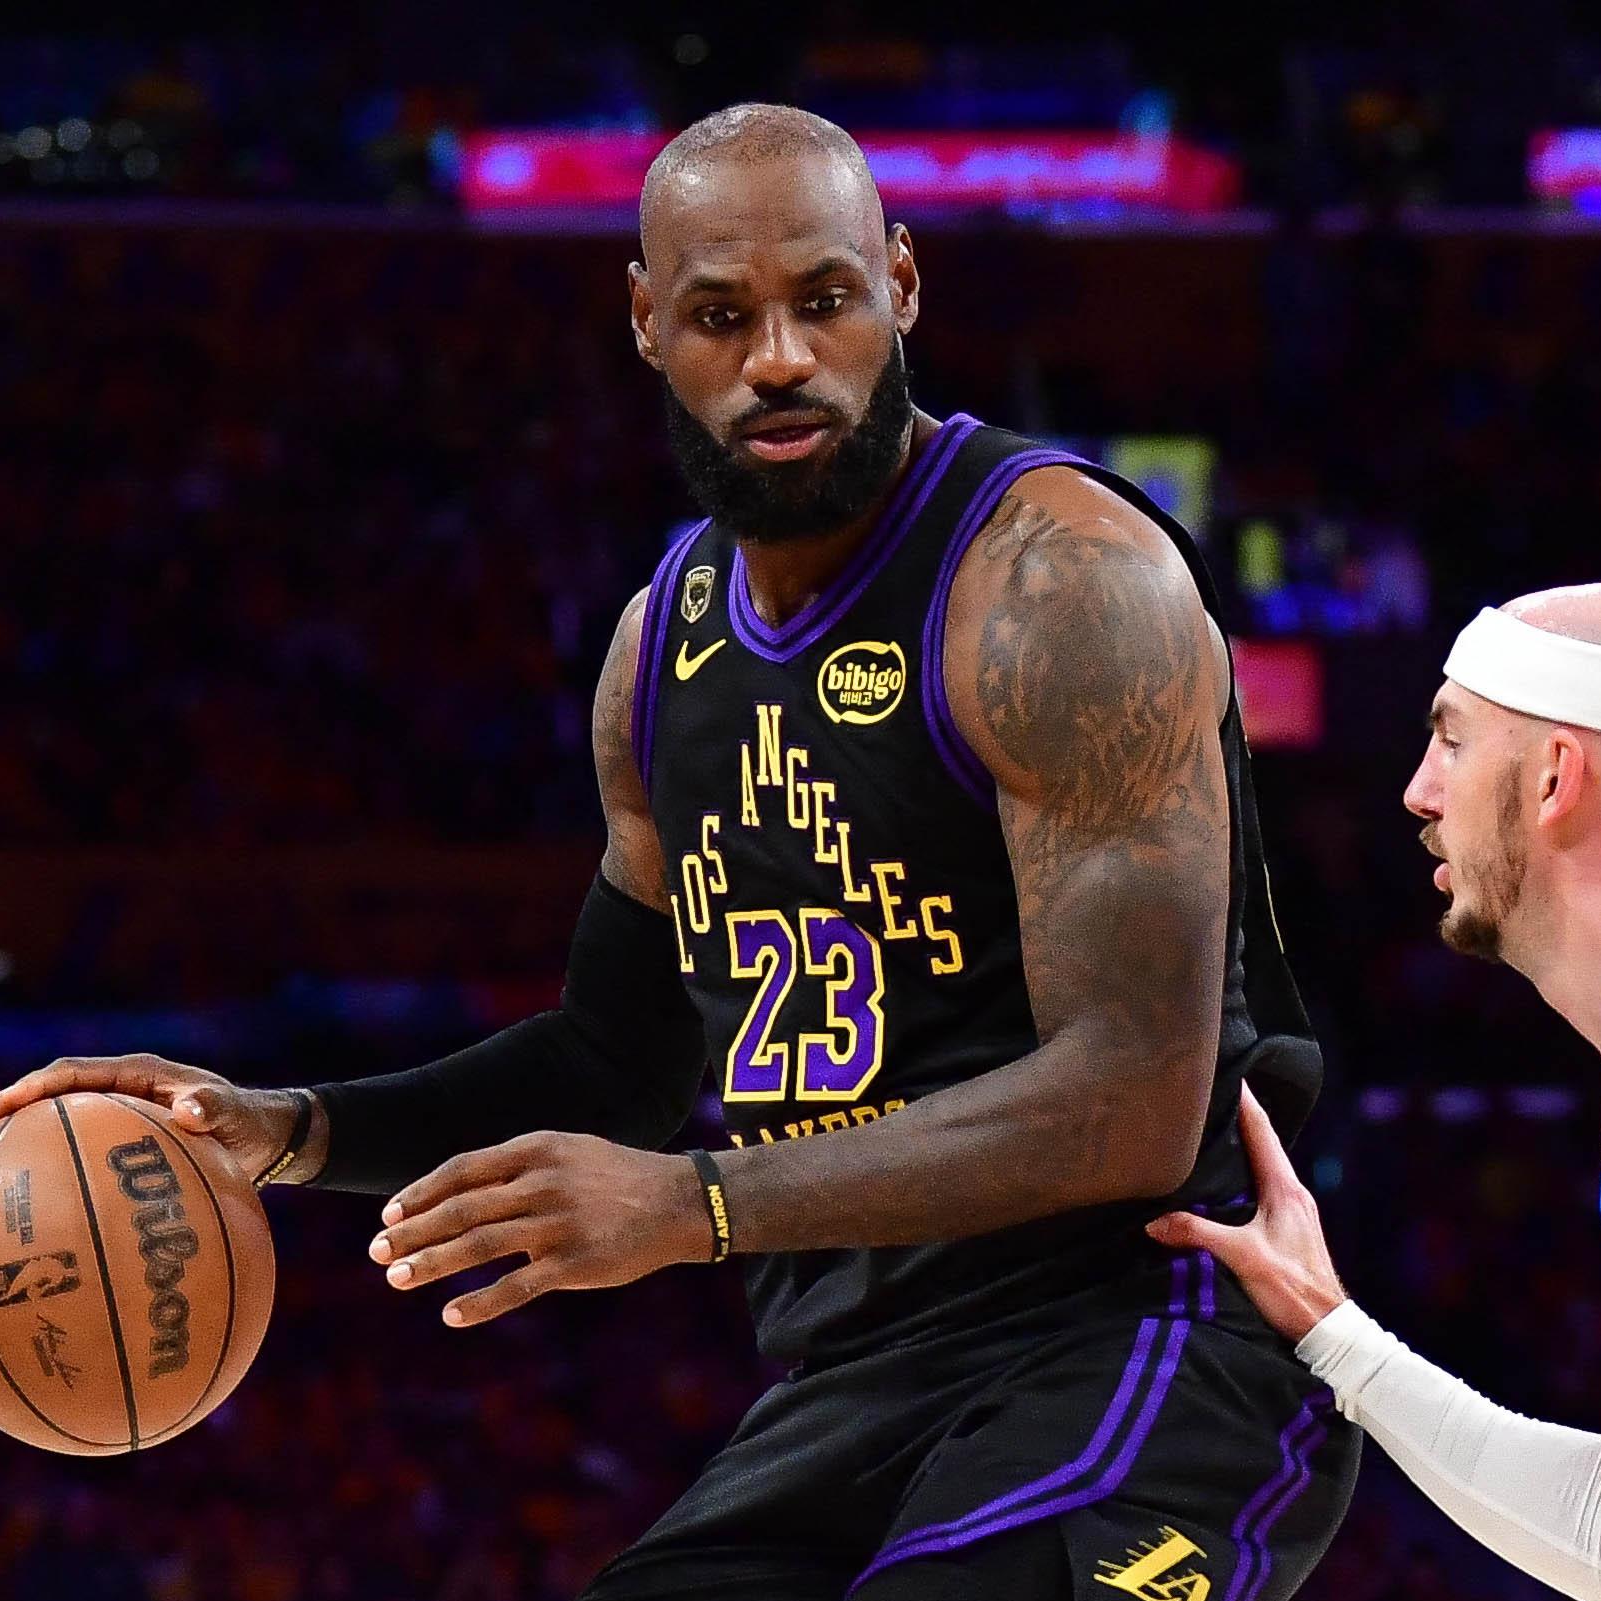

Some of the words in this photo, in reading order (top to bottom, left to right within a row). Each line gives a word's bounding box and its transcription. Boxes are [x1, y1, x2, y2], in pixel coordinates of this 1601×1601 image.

[828, 662, 901, 700] bibigo
[839, 691, 873, 706] 비비고
[670, 815, 728, 973] LOS
[741, 704, 964, 975] ANGELES
[723, 908, 885, 1102] 23
[106, 1135, 198, 1380] Wilson
[707, 1184, 730, 1239] AKRON
